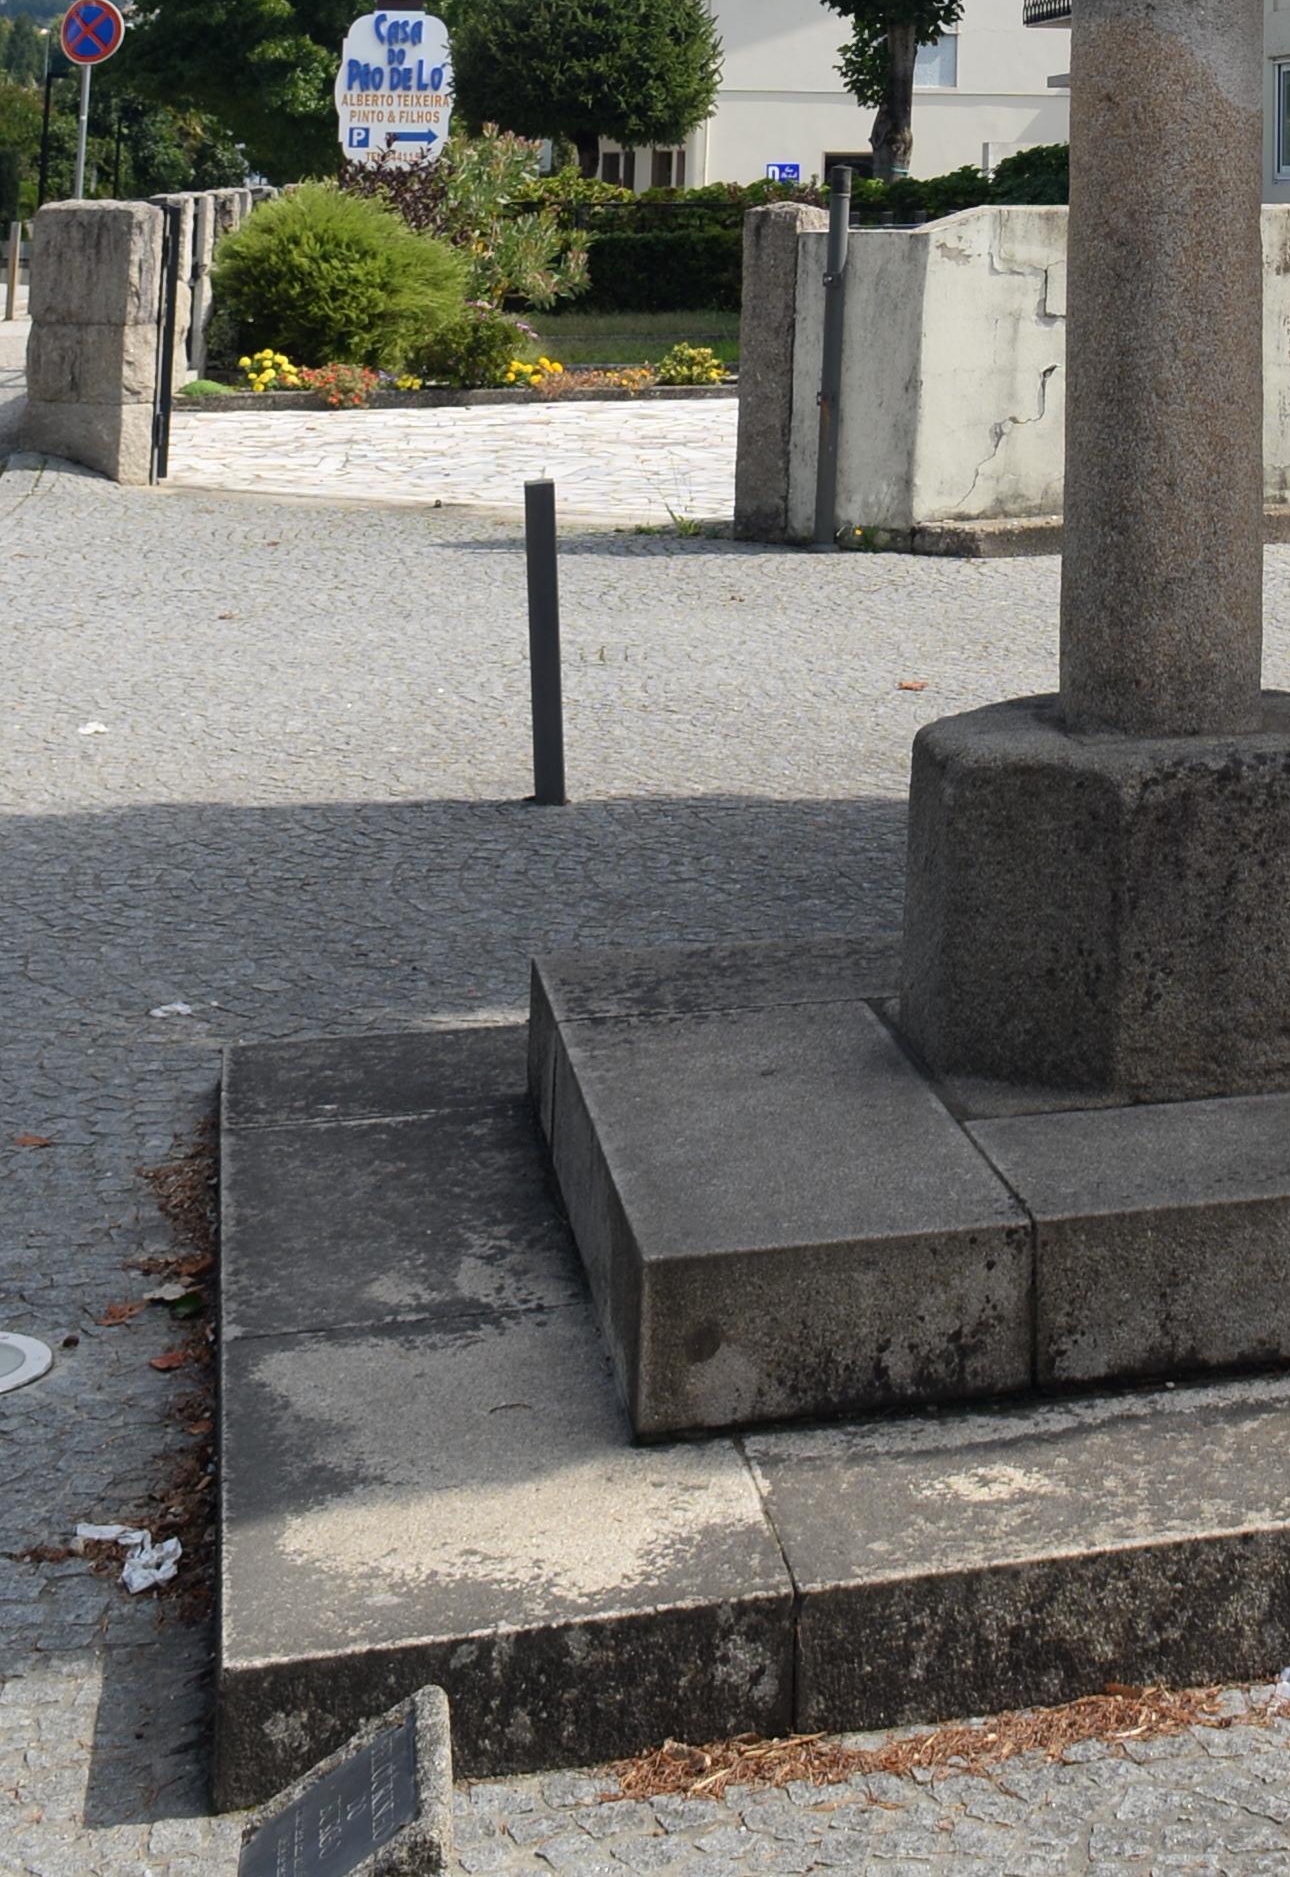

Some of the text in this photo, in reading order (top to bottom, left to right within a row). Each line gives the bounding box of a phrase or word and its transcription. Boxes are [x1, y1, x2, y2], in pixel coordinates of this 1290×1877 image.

[387, 48, 406, 66] DO
[389, 67, 413, 91] DE
[341, 93, 450, 108] ALBERTO TEIXEIRA
[350, 110, 440, 124] PINTO & FILHOS
[352, 128, 366, 147] P
